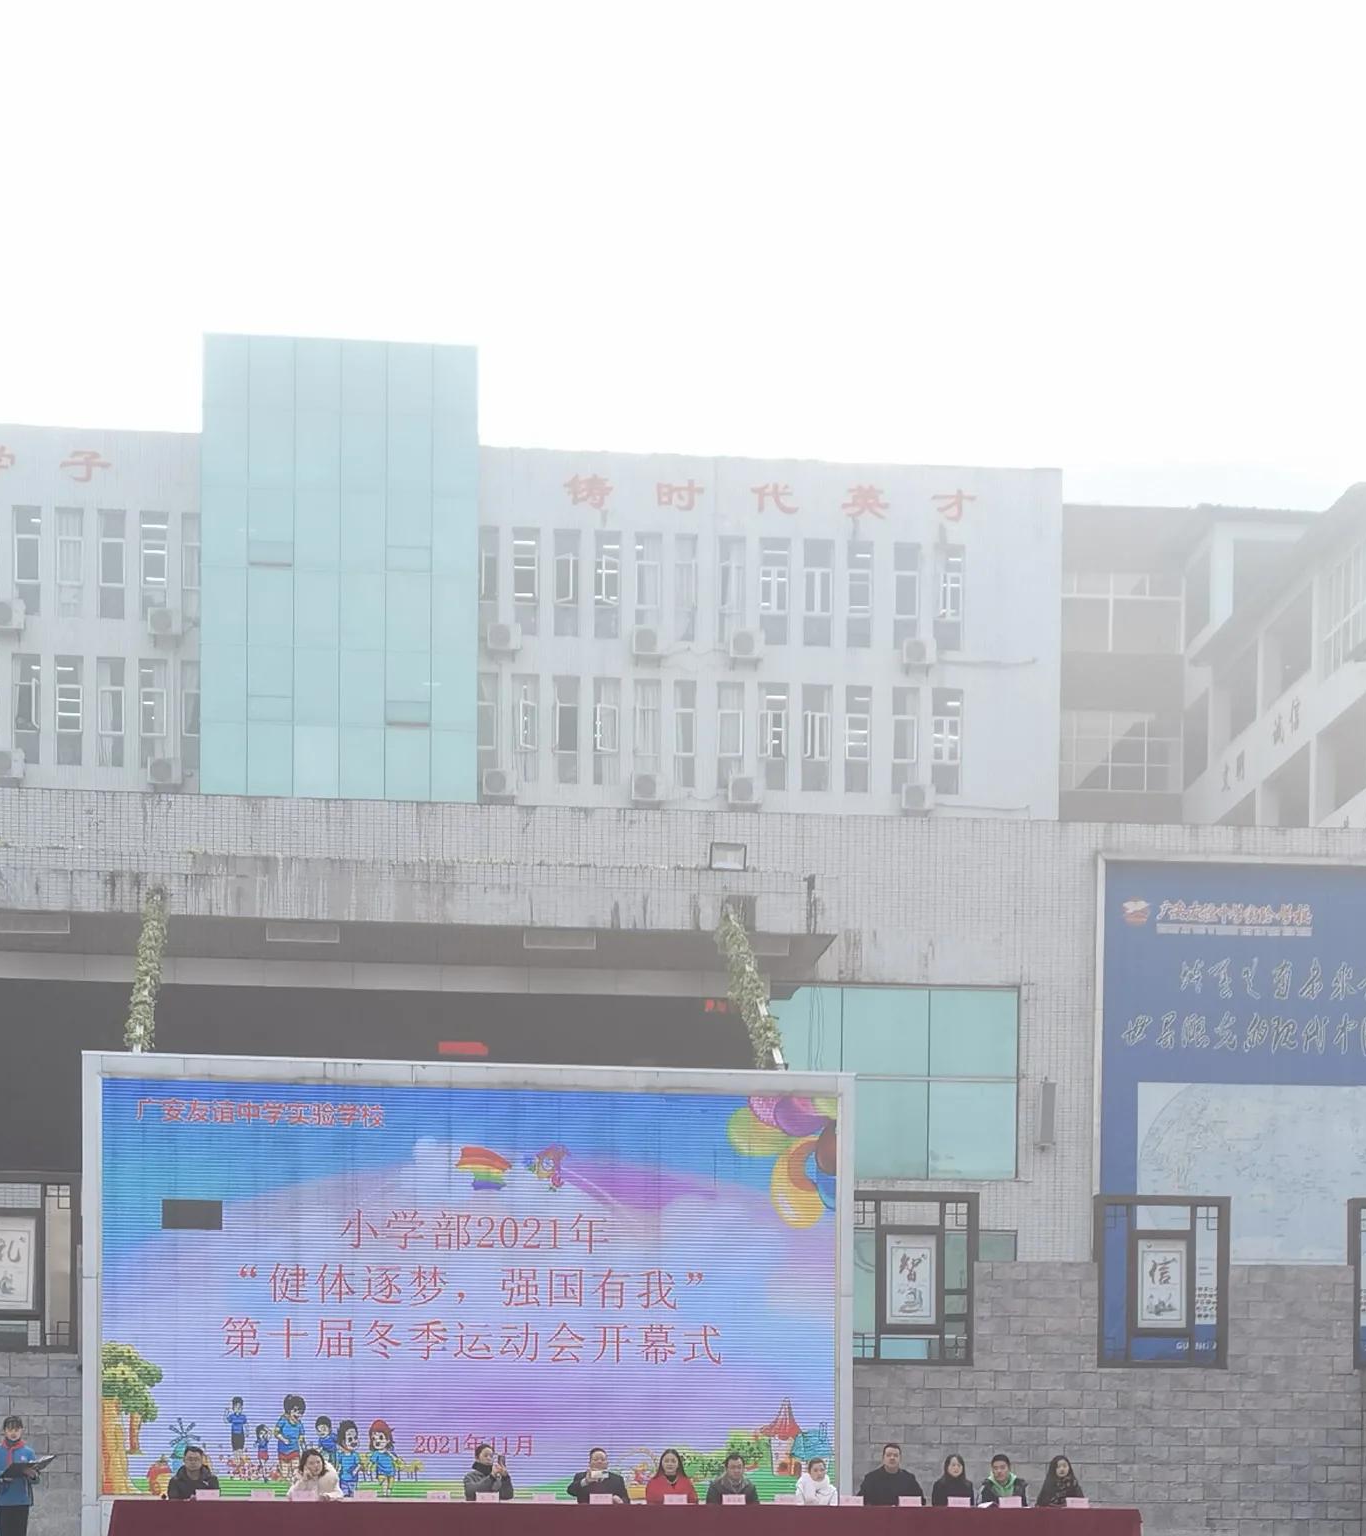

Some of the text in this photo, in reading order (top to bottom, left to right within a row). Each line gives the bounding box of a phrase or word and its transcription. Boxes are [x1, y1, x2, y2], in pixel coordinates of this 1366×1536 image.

[563, 473, 977, 522] 铸时代英才
[135, 1098, 385, 1128] 广安友谊中学实验学校
[340, 1210, 610, 1252] 小学部2021年
[898, 1253, 923, 1282] 智
[1148, 1256, 1177, 1285] 信
[238, 1263, 705, 1311] “健体逐梦，强国有我”
[223, 1315, 723, 1366] 第十届冬季运动会开幕式
[414, 1433, 533, 1457] 2021年11月
